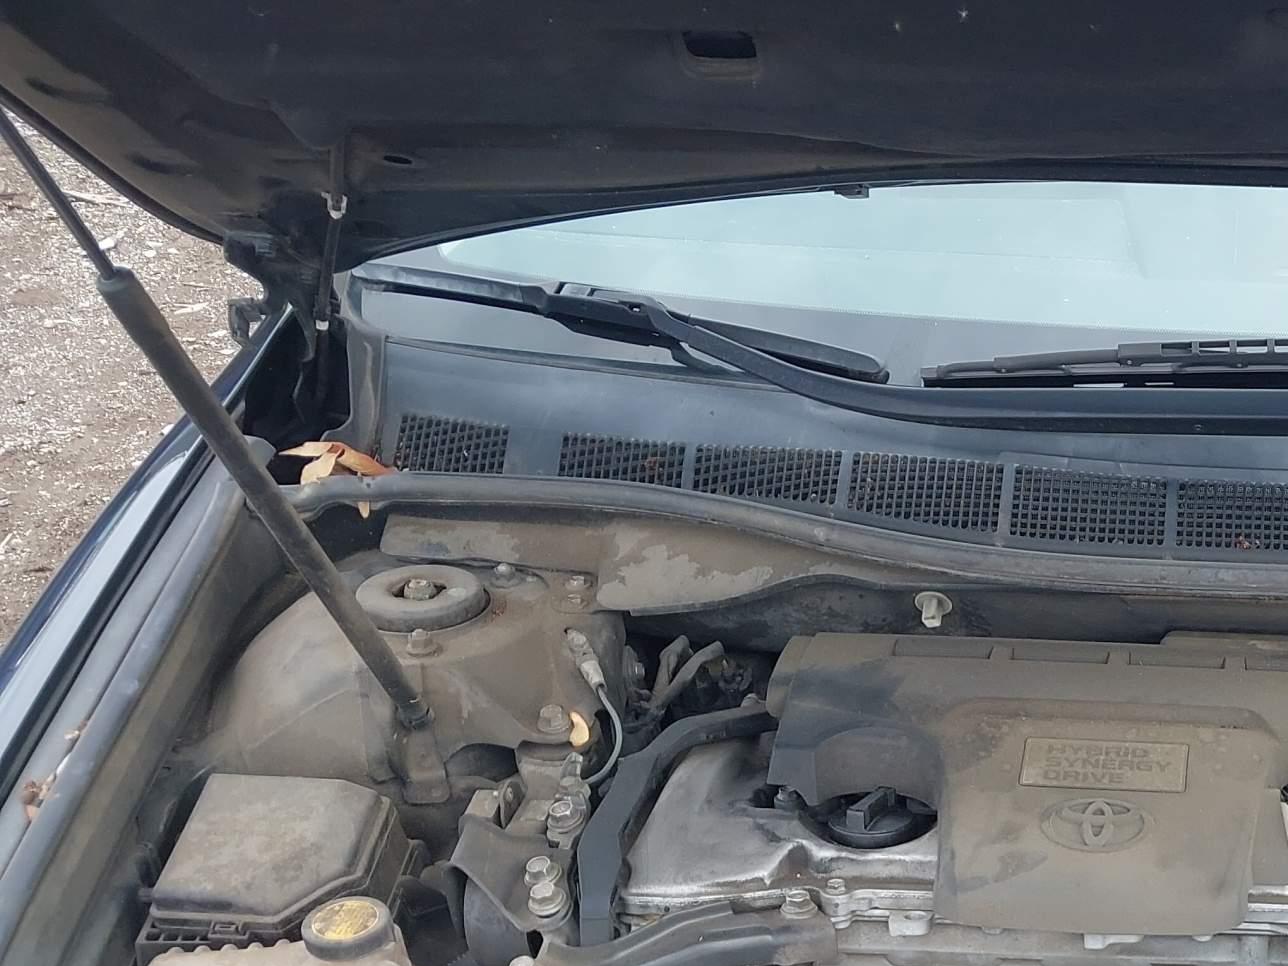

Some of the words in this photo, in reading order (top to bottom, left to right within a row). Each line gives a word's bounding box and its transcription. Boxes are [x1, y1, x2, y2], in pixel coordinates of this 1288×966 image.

[1047, 744, 1149, 759] HYBRID
[1045, 756, 1172, 772] SYNERGY
[1043, 770, 1125, 784] DRIVE
